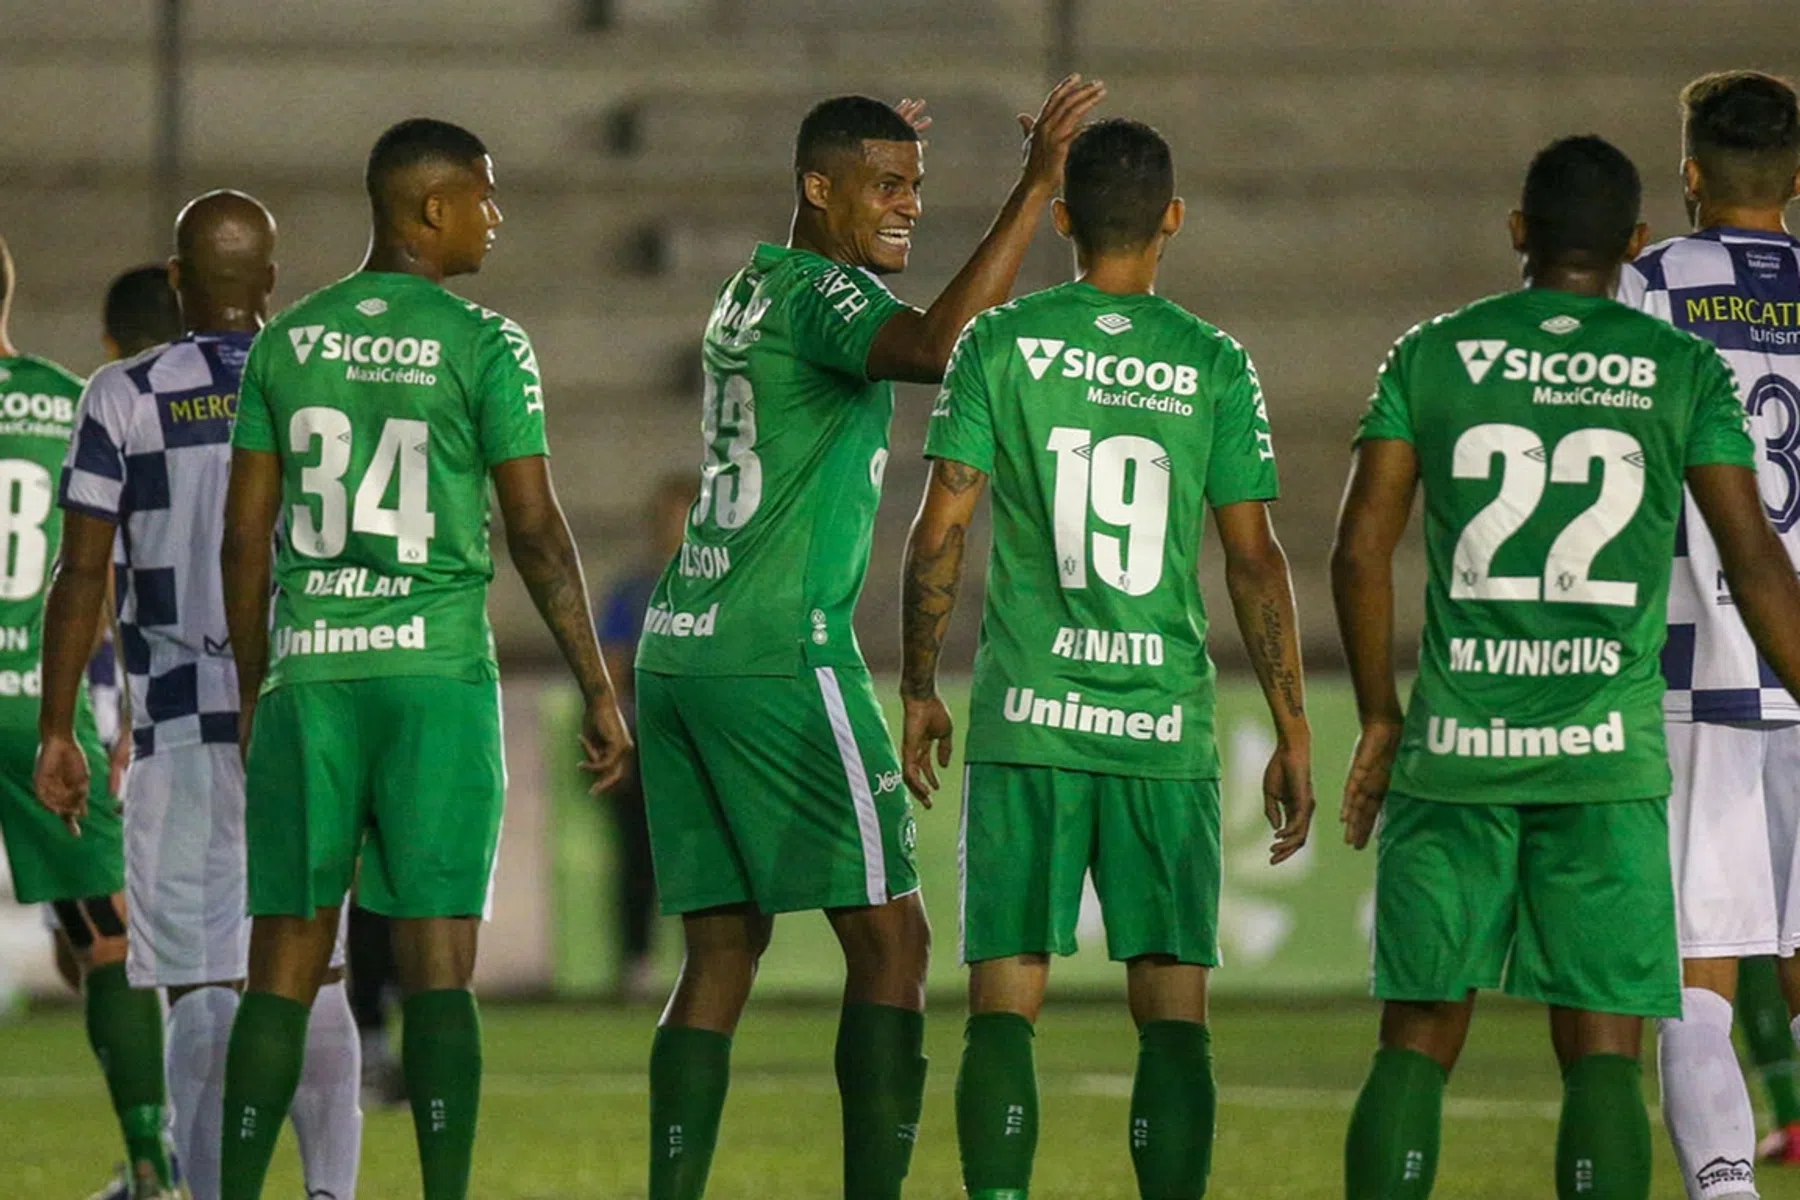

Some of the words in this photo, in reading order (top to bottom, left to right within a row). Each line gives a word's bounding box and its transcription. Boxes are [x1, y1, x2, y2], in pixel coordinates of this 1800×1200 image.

[1686, 295, 1800, 327] MERCAT
[321, 331, 441, 367] SICOOB
[1503, 349, 1657, 389] SICOOB
[346, 366, 437, 386] MaxiCrédito
[1062, 347, 1199, 396] SICOOB
[0, 392, 73, 422] OOB
[1086, 385, 1194, 417] MaxiCrédito
[1533, 386, 1653, 410] MaxiCrédito
[289, 406, 435, 564] 34
[1046, 426, 1171, 597] 19
[1450, 422, 1645, 607] 22
[304, 567, 413, 598] DERLAN
[275, 615, 426, 656] Unimed
[1051, 626, 1164, 666] RENATO
[1449, 637, 1622, 676] M.VINICIUS
[1003, 687, 1183, 743] Unimed
[1427, 710, 1625, 758] Unimed
